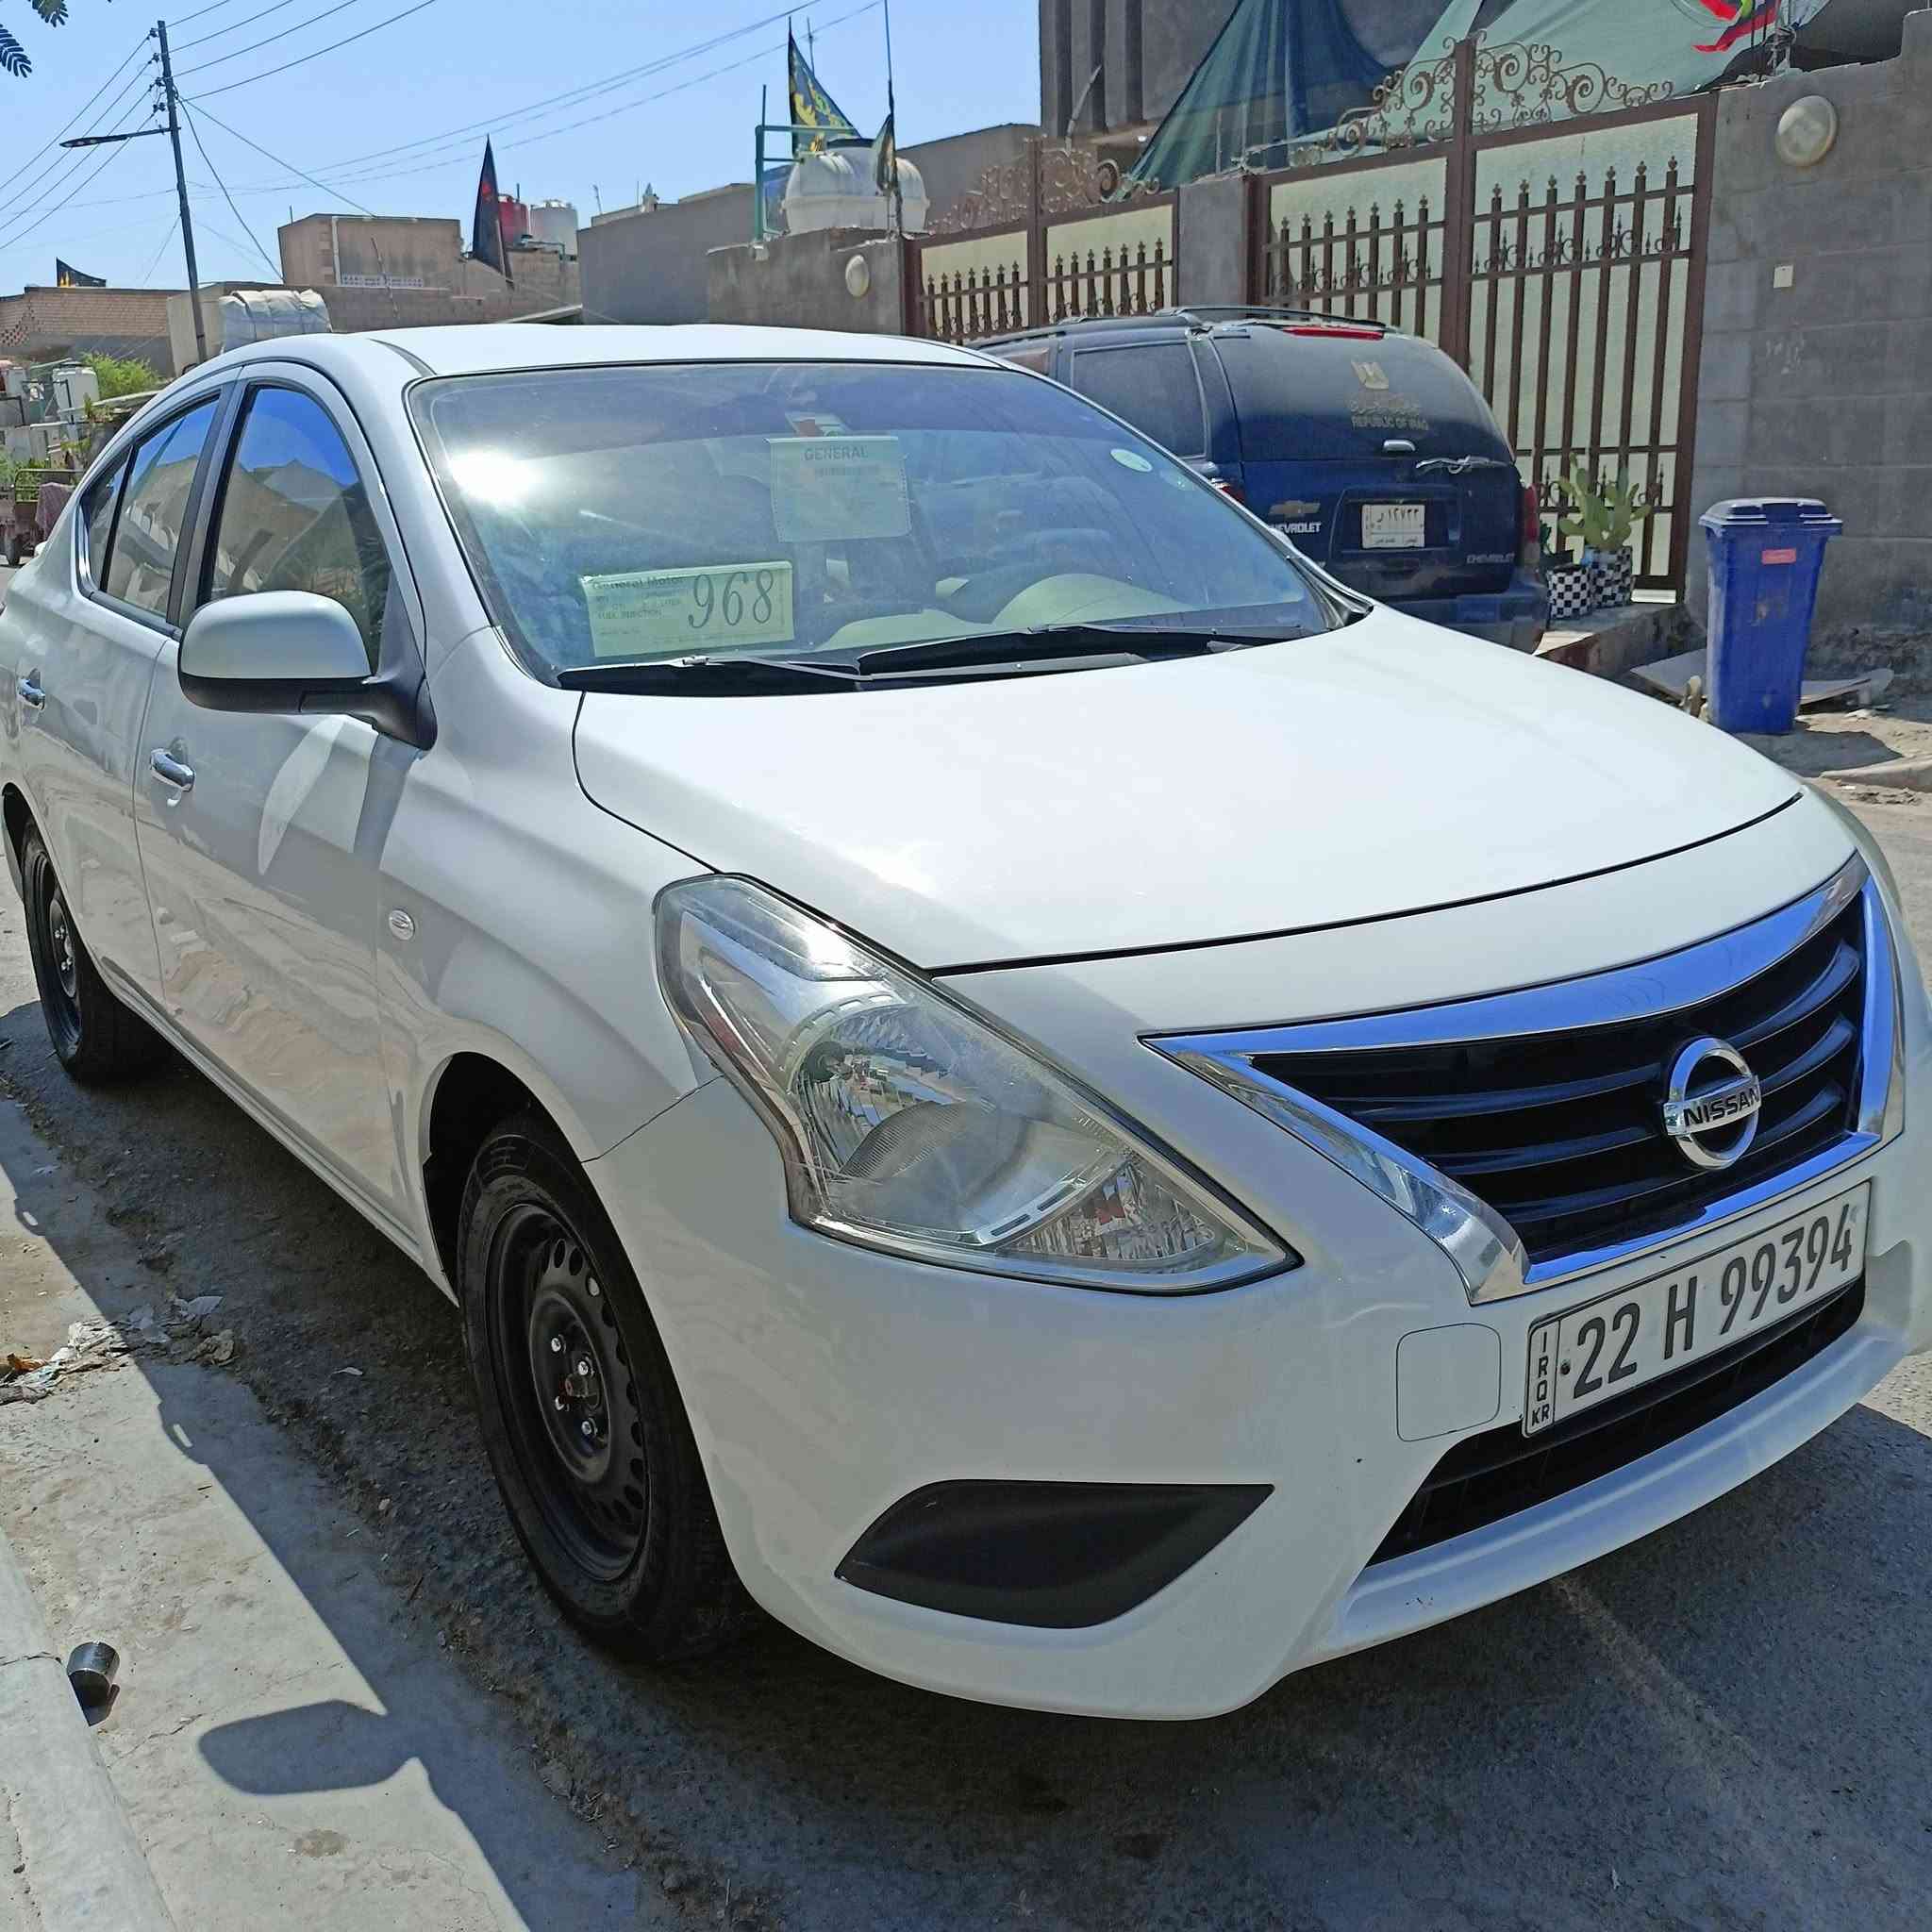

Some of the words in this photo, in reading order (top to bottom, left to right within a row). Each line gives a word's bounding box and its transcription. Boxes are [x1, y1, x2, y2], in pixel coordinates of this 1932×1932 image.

[804, 444, 869, 460] GENERAL
[688, 568, 774, 628] 968
[1683, 1082, 1761, 1126] NISSAN
[1573, 1302, 1641, 1399] 22
[1663, 1275, 1697, 1360] H
[1720, 1203, 1852, 1336] 99394
[1531, 1405, 1550, 1425] KR
